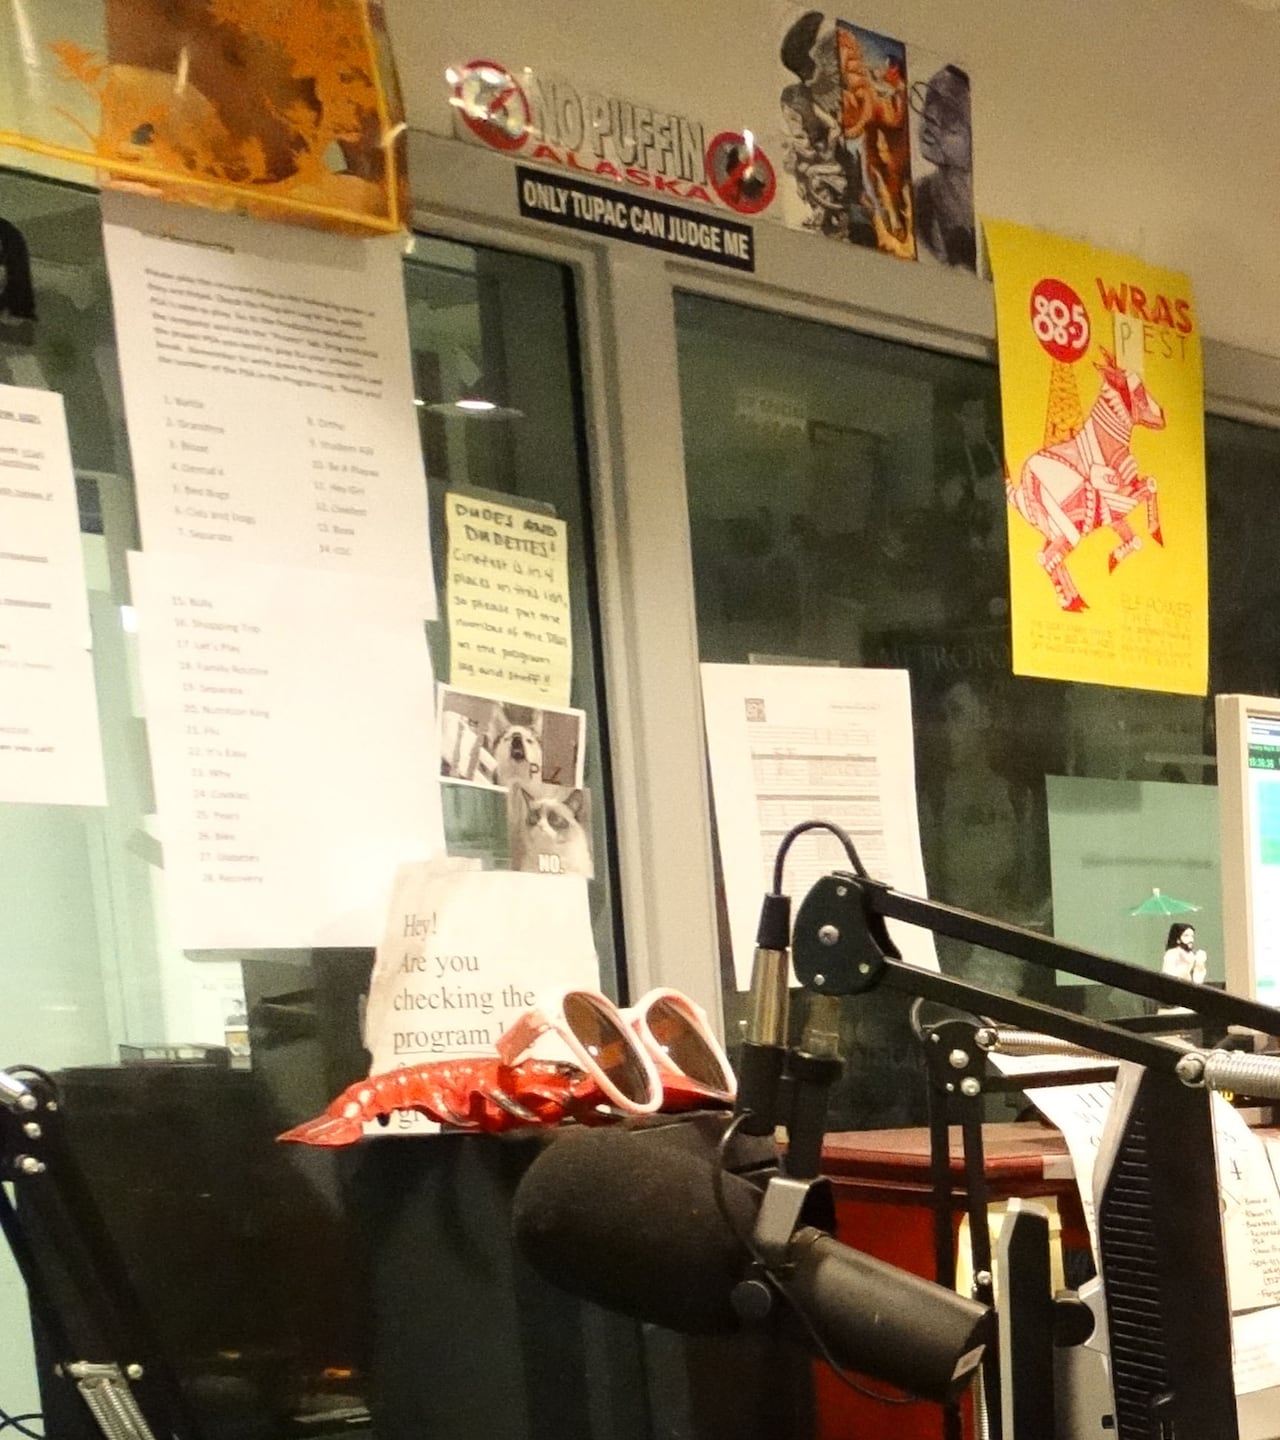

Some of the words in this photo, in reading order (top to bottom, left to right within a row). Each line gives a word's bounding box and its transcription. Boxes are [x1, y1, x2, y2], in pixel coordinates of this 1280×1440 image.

[532, 145, 720, 204] ALASKA
[522, 179, 568, 215] ONLY
[571, 191, 628, 230] TUPAC
[630, 205, 666, 240] CAN
[667, 218, 722, 253] JUDGE
[723, 232, 750, 260] ME
[1095, 276, 1193, 335] WRAS
[402, 912, 438, 942] Hey!
[397, 951, 428, 975] Are
[434, 953, 481, 980] you
[392, 984, 495, 1015] checking
[501, 983, 537, 1009] the
[392, 1027, 493, 1056] program
